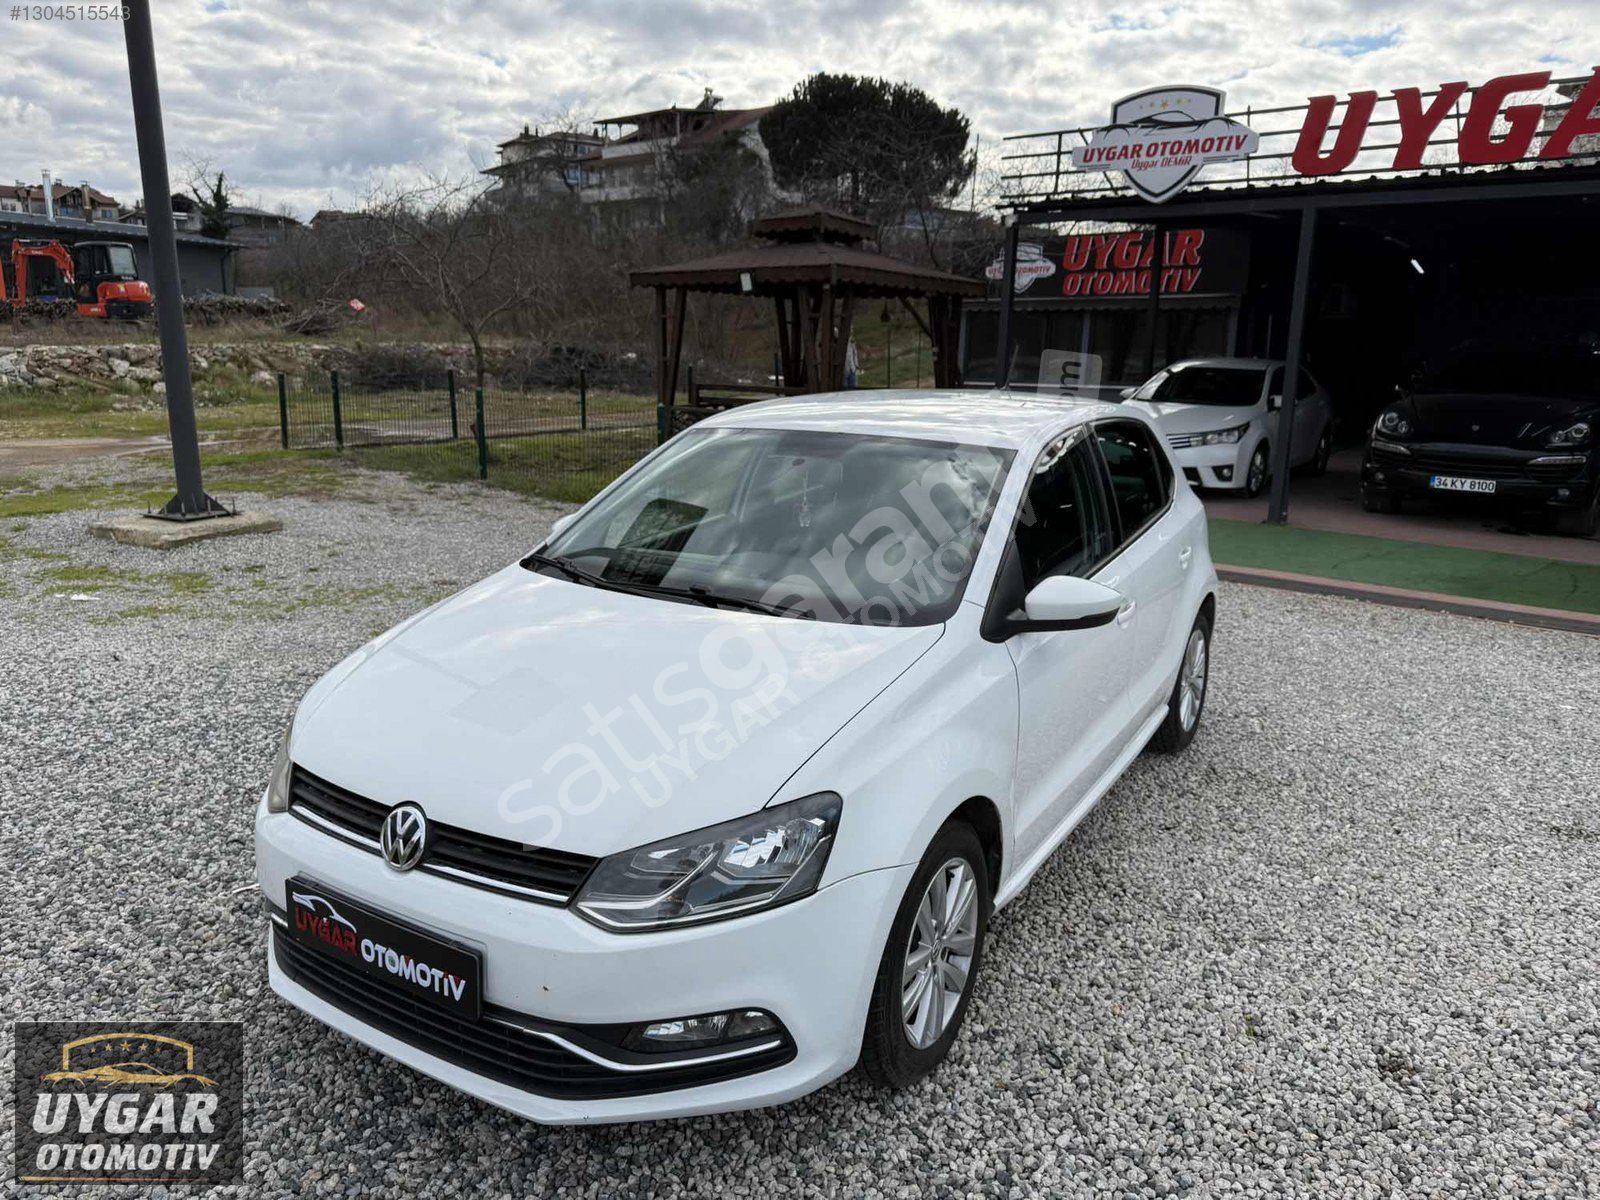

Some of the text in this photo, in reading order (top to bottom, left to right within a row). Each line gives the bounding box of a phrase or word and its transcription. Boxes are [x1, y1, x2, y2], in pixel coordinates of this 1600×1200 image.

[1082, 143, 1142, 164] UYGAR
[1131, 158, 1159, 172] Uygar
[1062, 229, 1206, 271] UYGAR
[1436, 477, 1448, 487] 34
[1469, 480, 1494, 492] 8100
[294, 905, 358, 956] UYGAR
